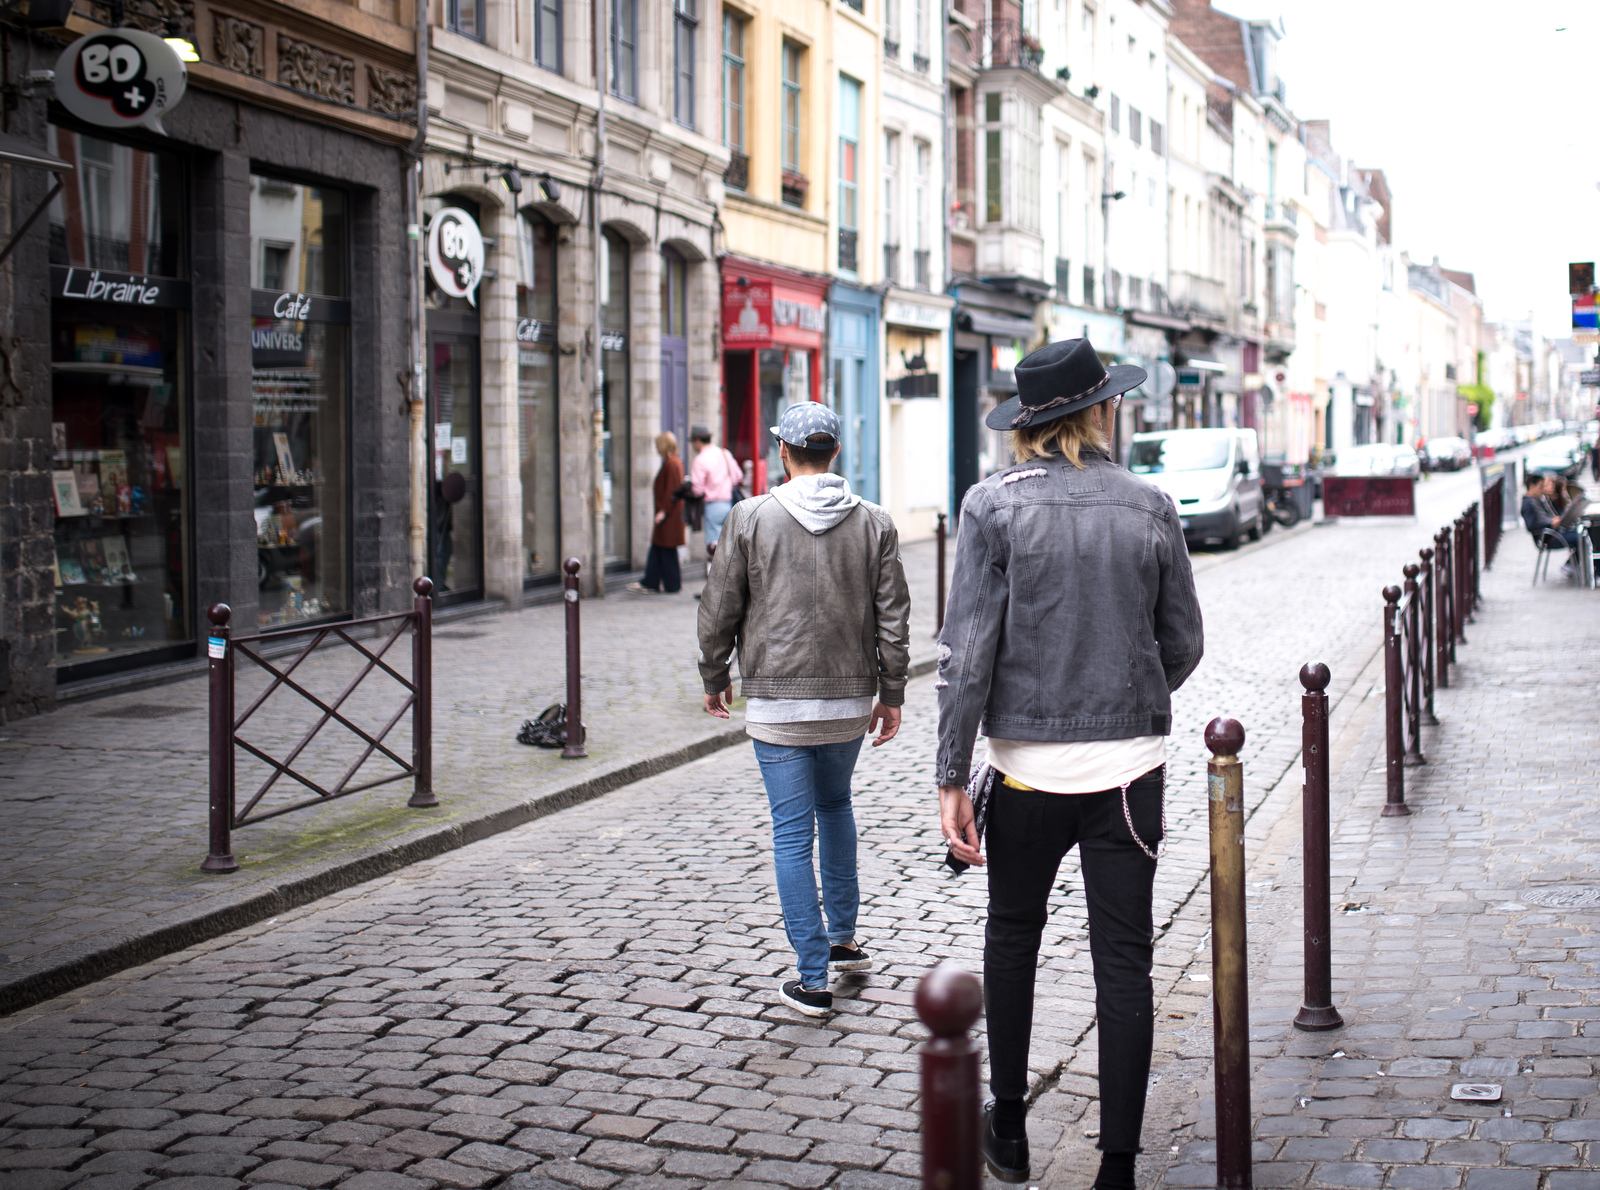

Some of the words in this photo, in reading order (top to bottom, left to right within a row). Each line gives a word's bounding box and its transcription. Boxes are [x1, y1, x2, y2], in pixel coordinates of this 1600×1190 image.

[81, 43, 141, 83] BD
[62, 267, 160, 304] Librairie
[273, 292, 312, 320] Café
[251, 329, 303, 351] UNIVERS
